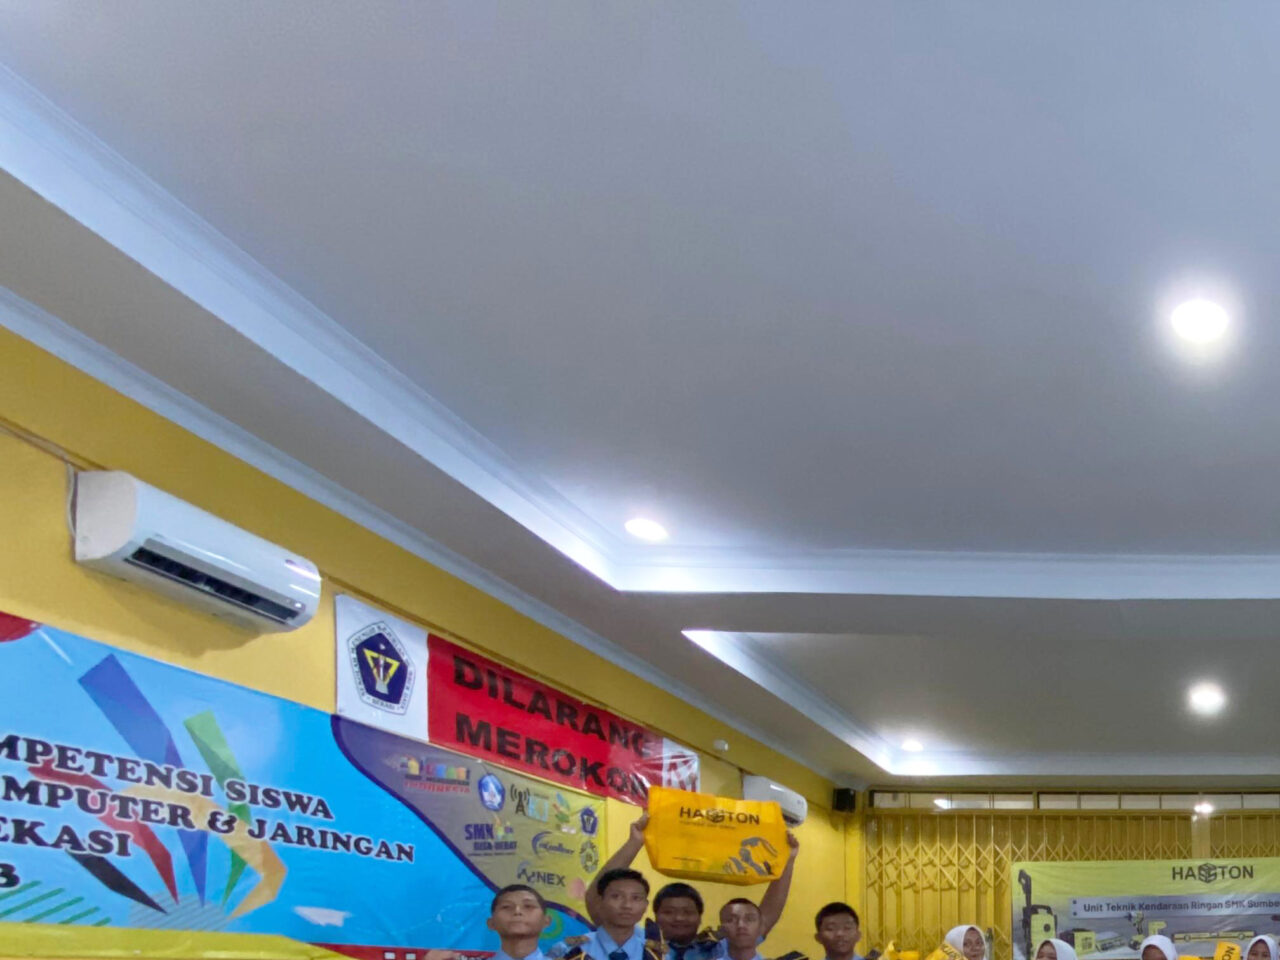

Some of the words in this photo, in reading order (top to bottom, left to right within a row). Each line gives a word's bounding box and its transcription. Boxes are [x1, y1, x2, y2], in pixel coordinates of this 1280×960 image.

[2, 775, 196, 830] MPUTER
[207, 810, 238, 834] &
[247, 818, 416, 864] JARINGAN
[225, 780, 334, 820] SISWA
[1083, 903, 1103, 913] Unit
[1105, 902, 1136, 912] Teknik
[1190, 900, 1224, 912] Ringan
[1224, 900, 1245, 909] SMK
